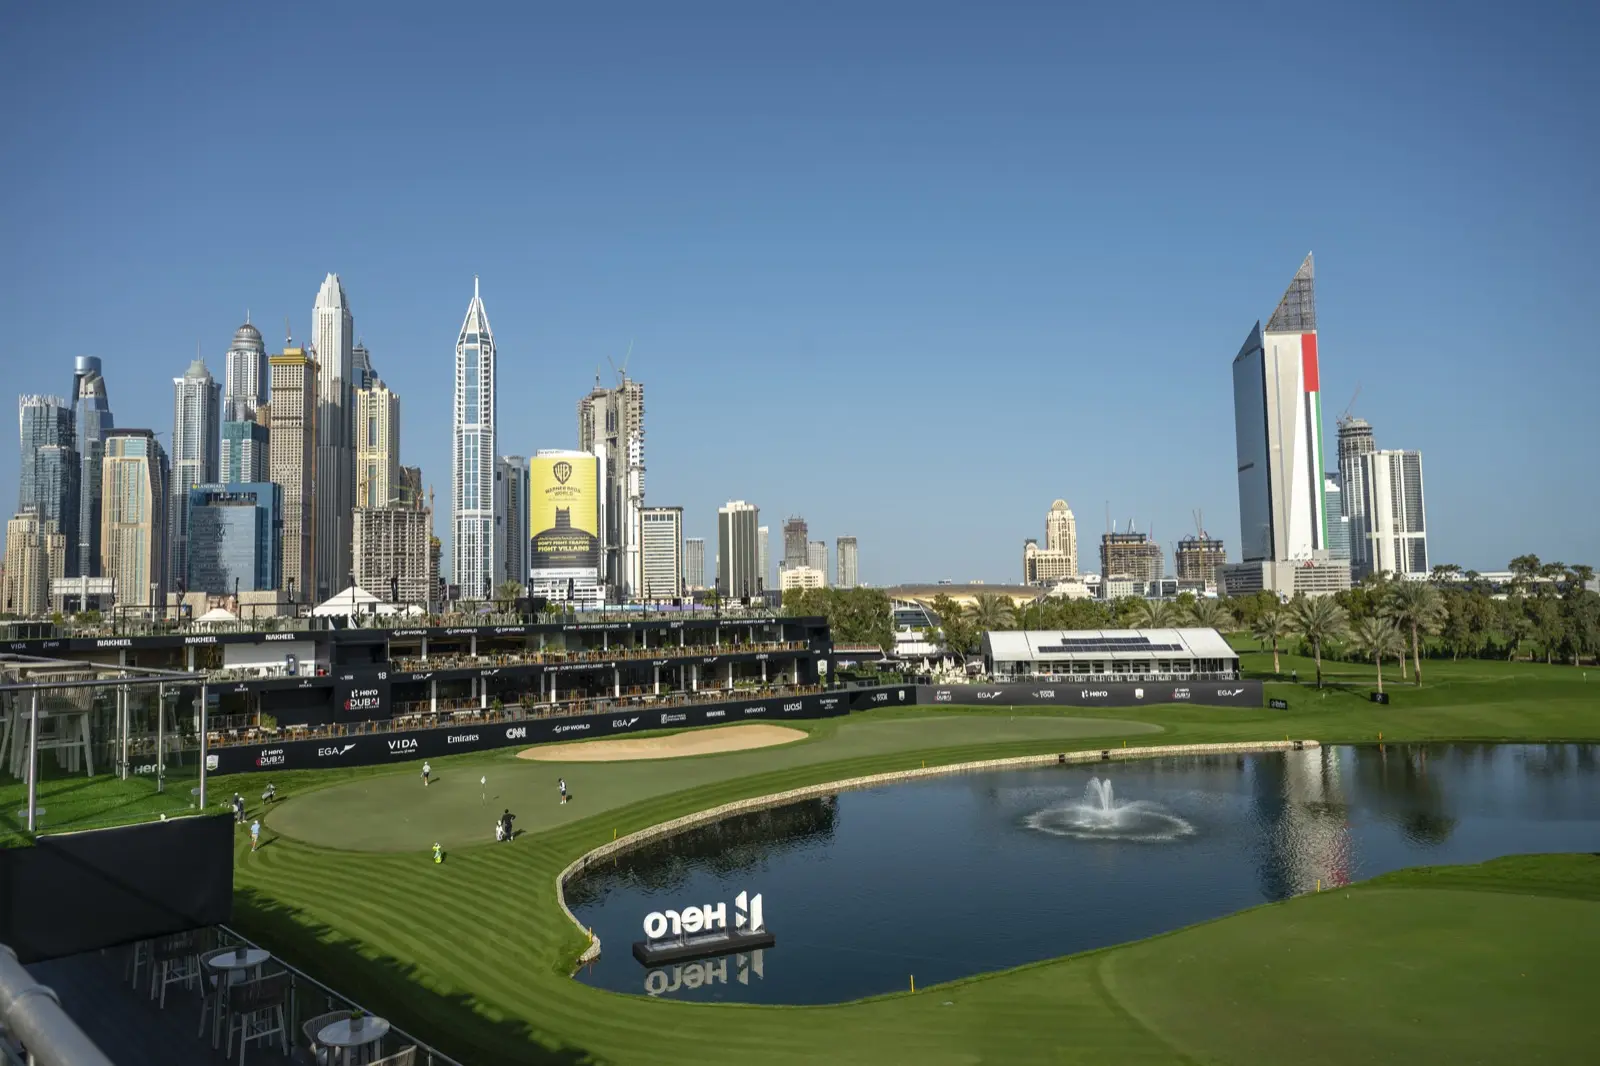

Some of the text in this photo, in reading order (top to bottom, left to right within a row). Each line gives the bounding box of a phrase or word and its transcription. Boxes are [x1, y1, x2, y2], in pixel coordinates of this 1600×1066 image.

[378, 672, 387, 680] 18
[506, 727, 526, 739] CNN
[448, 734, 480, 743] Emirates
[388, 739, 418, 749] VIDA
[318, 747, 339, 756] EGA
